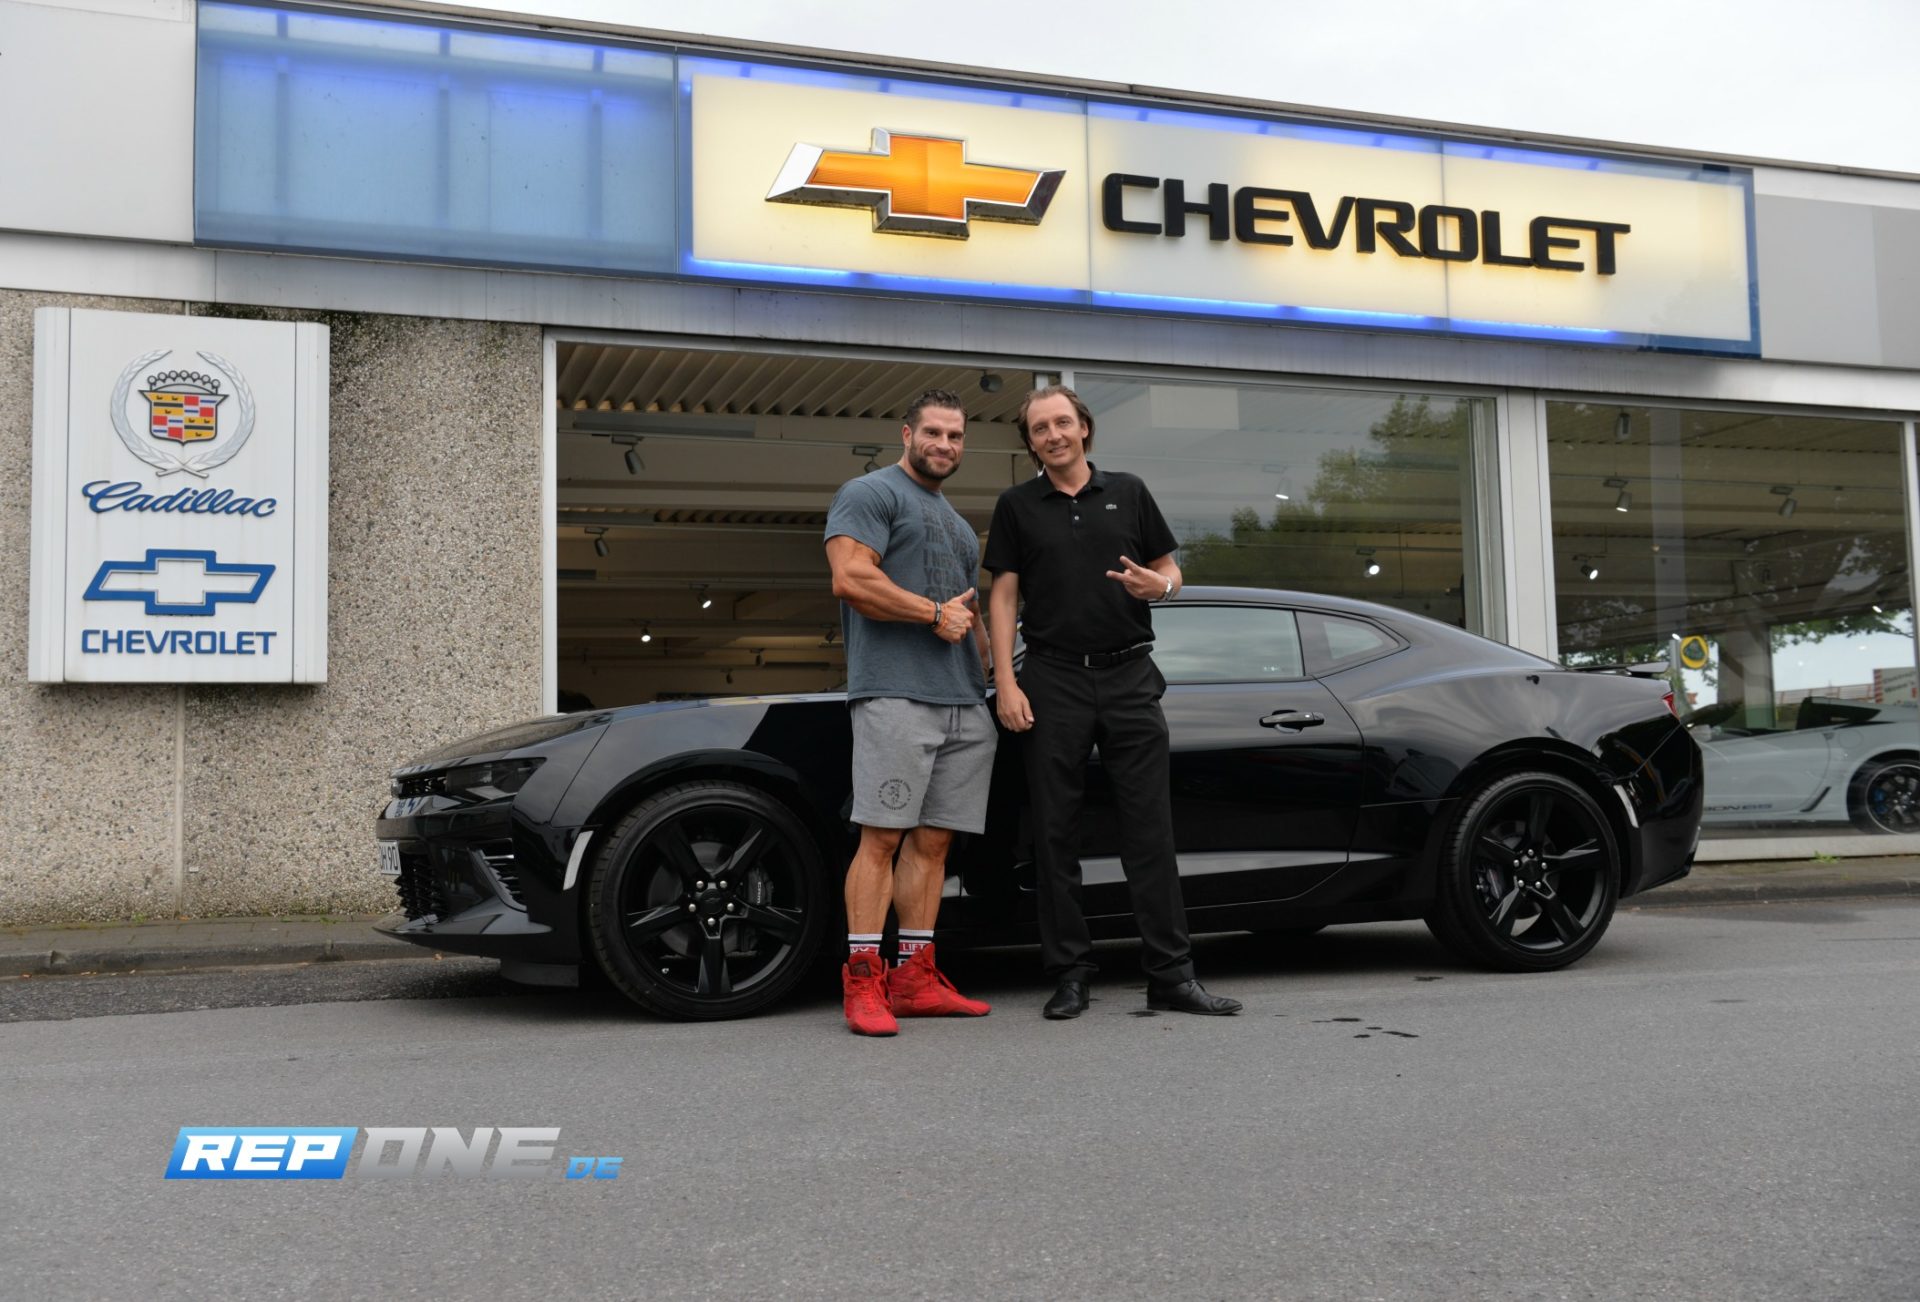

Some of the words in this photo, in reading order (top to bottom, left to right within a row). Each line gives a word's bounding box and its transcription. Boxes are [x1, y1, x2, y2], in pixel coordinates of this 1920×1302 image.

[1103, 173, 1631, 276] CHEVROLET
[82, 480, 277, 517] Cadillac
[82, 630, 277, 655] CHEVROLET
